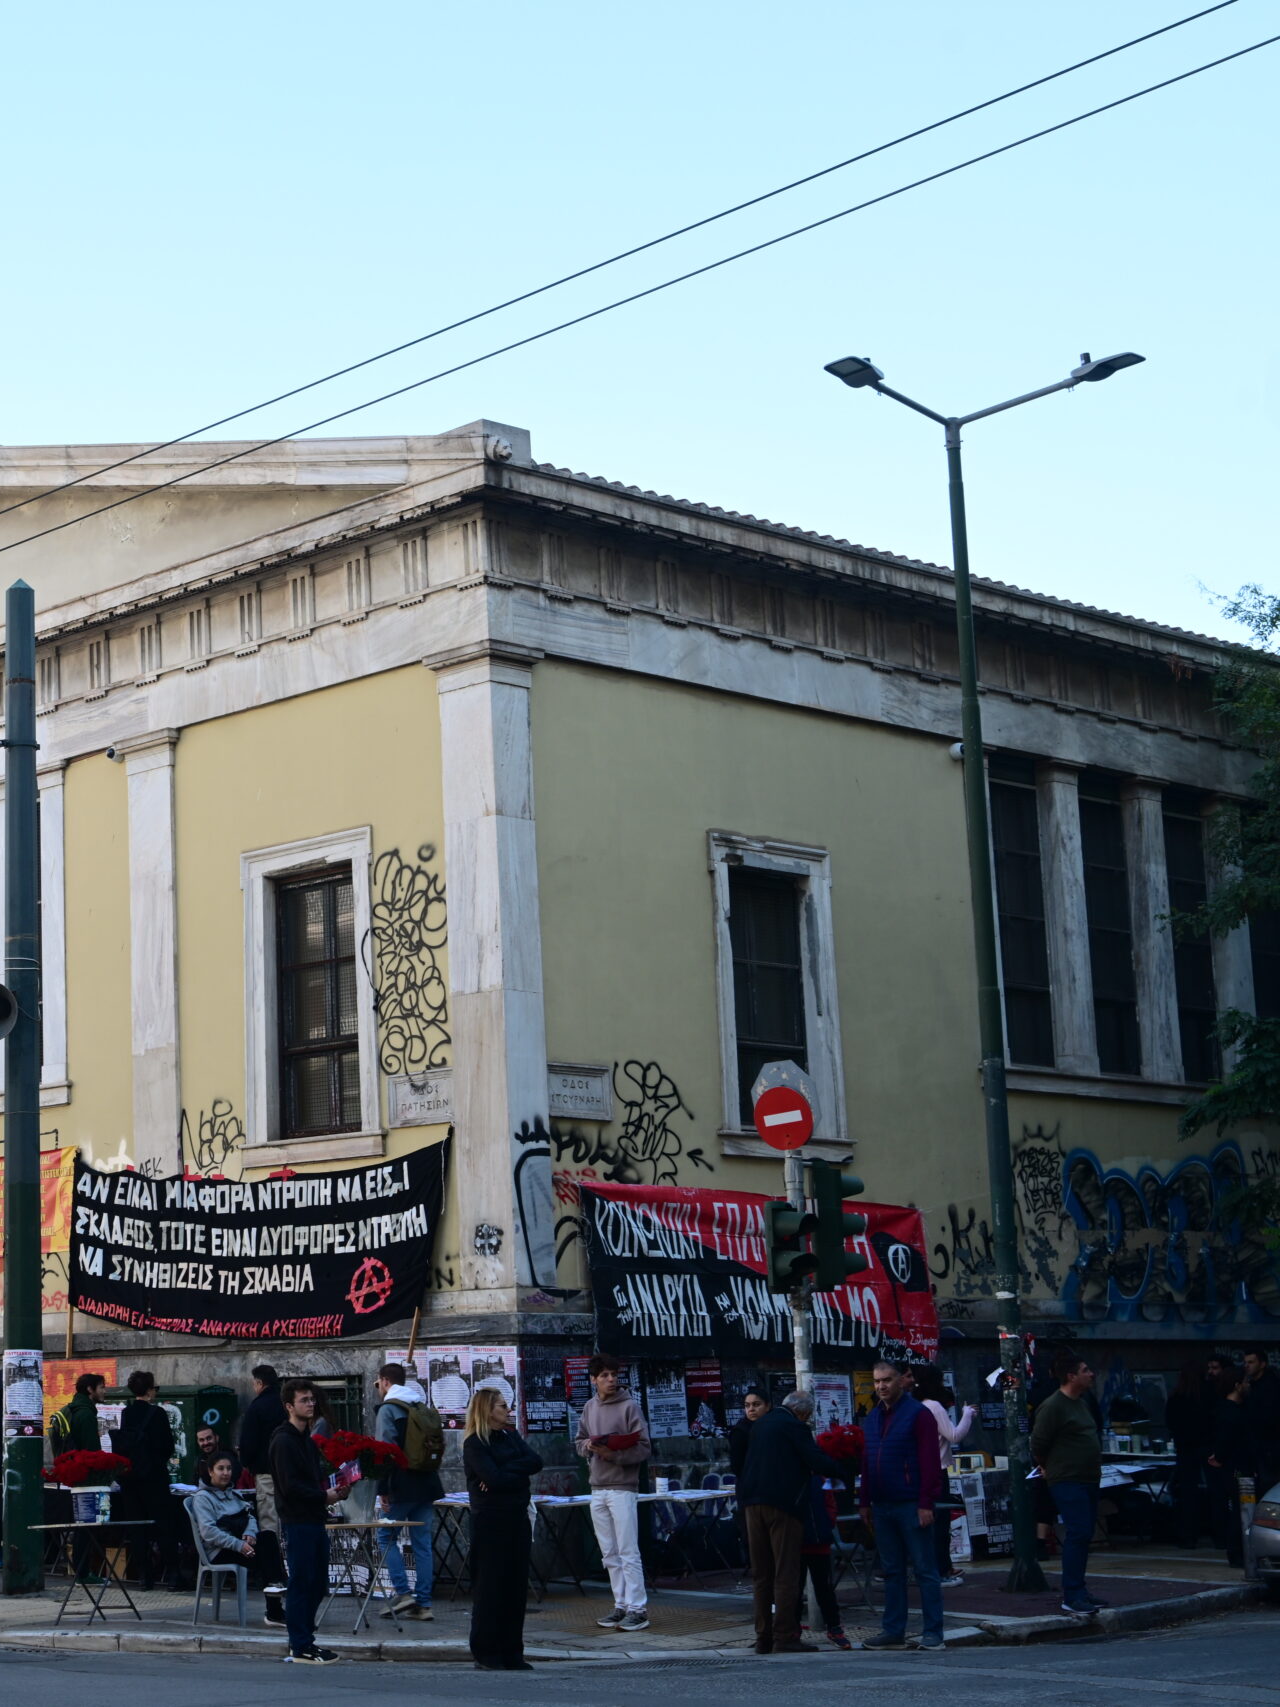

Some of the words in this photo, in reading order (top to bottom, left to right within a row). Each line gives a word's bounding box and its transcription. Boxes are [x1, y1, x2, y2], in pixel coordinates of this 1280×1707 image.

[401, 1098, 449, 1113] ΠΑΤΗΣΙΩΝ
[562, 1078, 589, 1089] ΟΔΟΣ
[76, 1171, 110, 1204] ΑΝ
[114, 1176, 158, 1211] ΕΙΝΑΙ
[165, 1179, 198, 1211] ΜΙΑ
[198, 1182, 255, 1214] ΦΟΡΑ
[258, 1177, 332, 1211] ΝΤΡΟΠΗ
[337, 1174, 363, 1204] ΝΑ
[365, 1161, 409, 1200] ΕΙΣΙ
[75, 1206, 158, 1254] ΣΚΛΑΒΟΣ,
[159, 1220, 207, 1254] ΤΟΤΕ
[211, 1227, 257, 1257] ΕΙΝΑΙ
[259, 1225, 293, 1256] ΔΥΟ
[294, 1222, 356, 1255] ΦΟΡΕΣ
[358, 1203, 428, 1251] ΝΤΡΟΠΗ
[595, 1198, 704, 1260] ΚΟΙΝΩΝΙΚΗ
[78, 1243, 103, 1277] ΝΑ
[108, 1254, 214, 1291] ΣΥΝΗΘΙΖΕΙΣ
[218, 1270, 240, 1295] ΤΗ
[242, 1263, 314, 1295] ΣΚΛΑΒΙΑ
[77, 1294, 130, 1323] ΔΙΑΔΡΟΜΗ
[199, 1318, 259, 1337] ΑΝΑΡΧΙΚΗ
[260, 1313, 344, 1338] ΑΡΧΕΙΟΘΗΚΗ
[625, 1273, 712, 1337] ΑΝΑΡΧΙΑ
